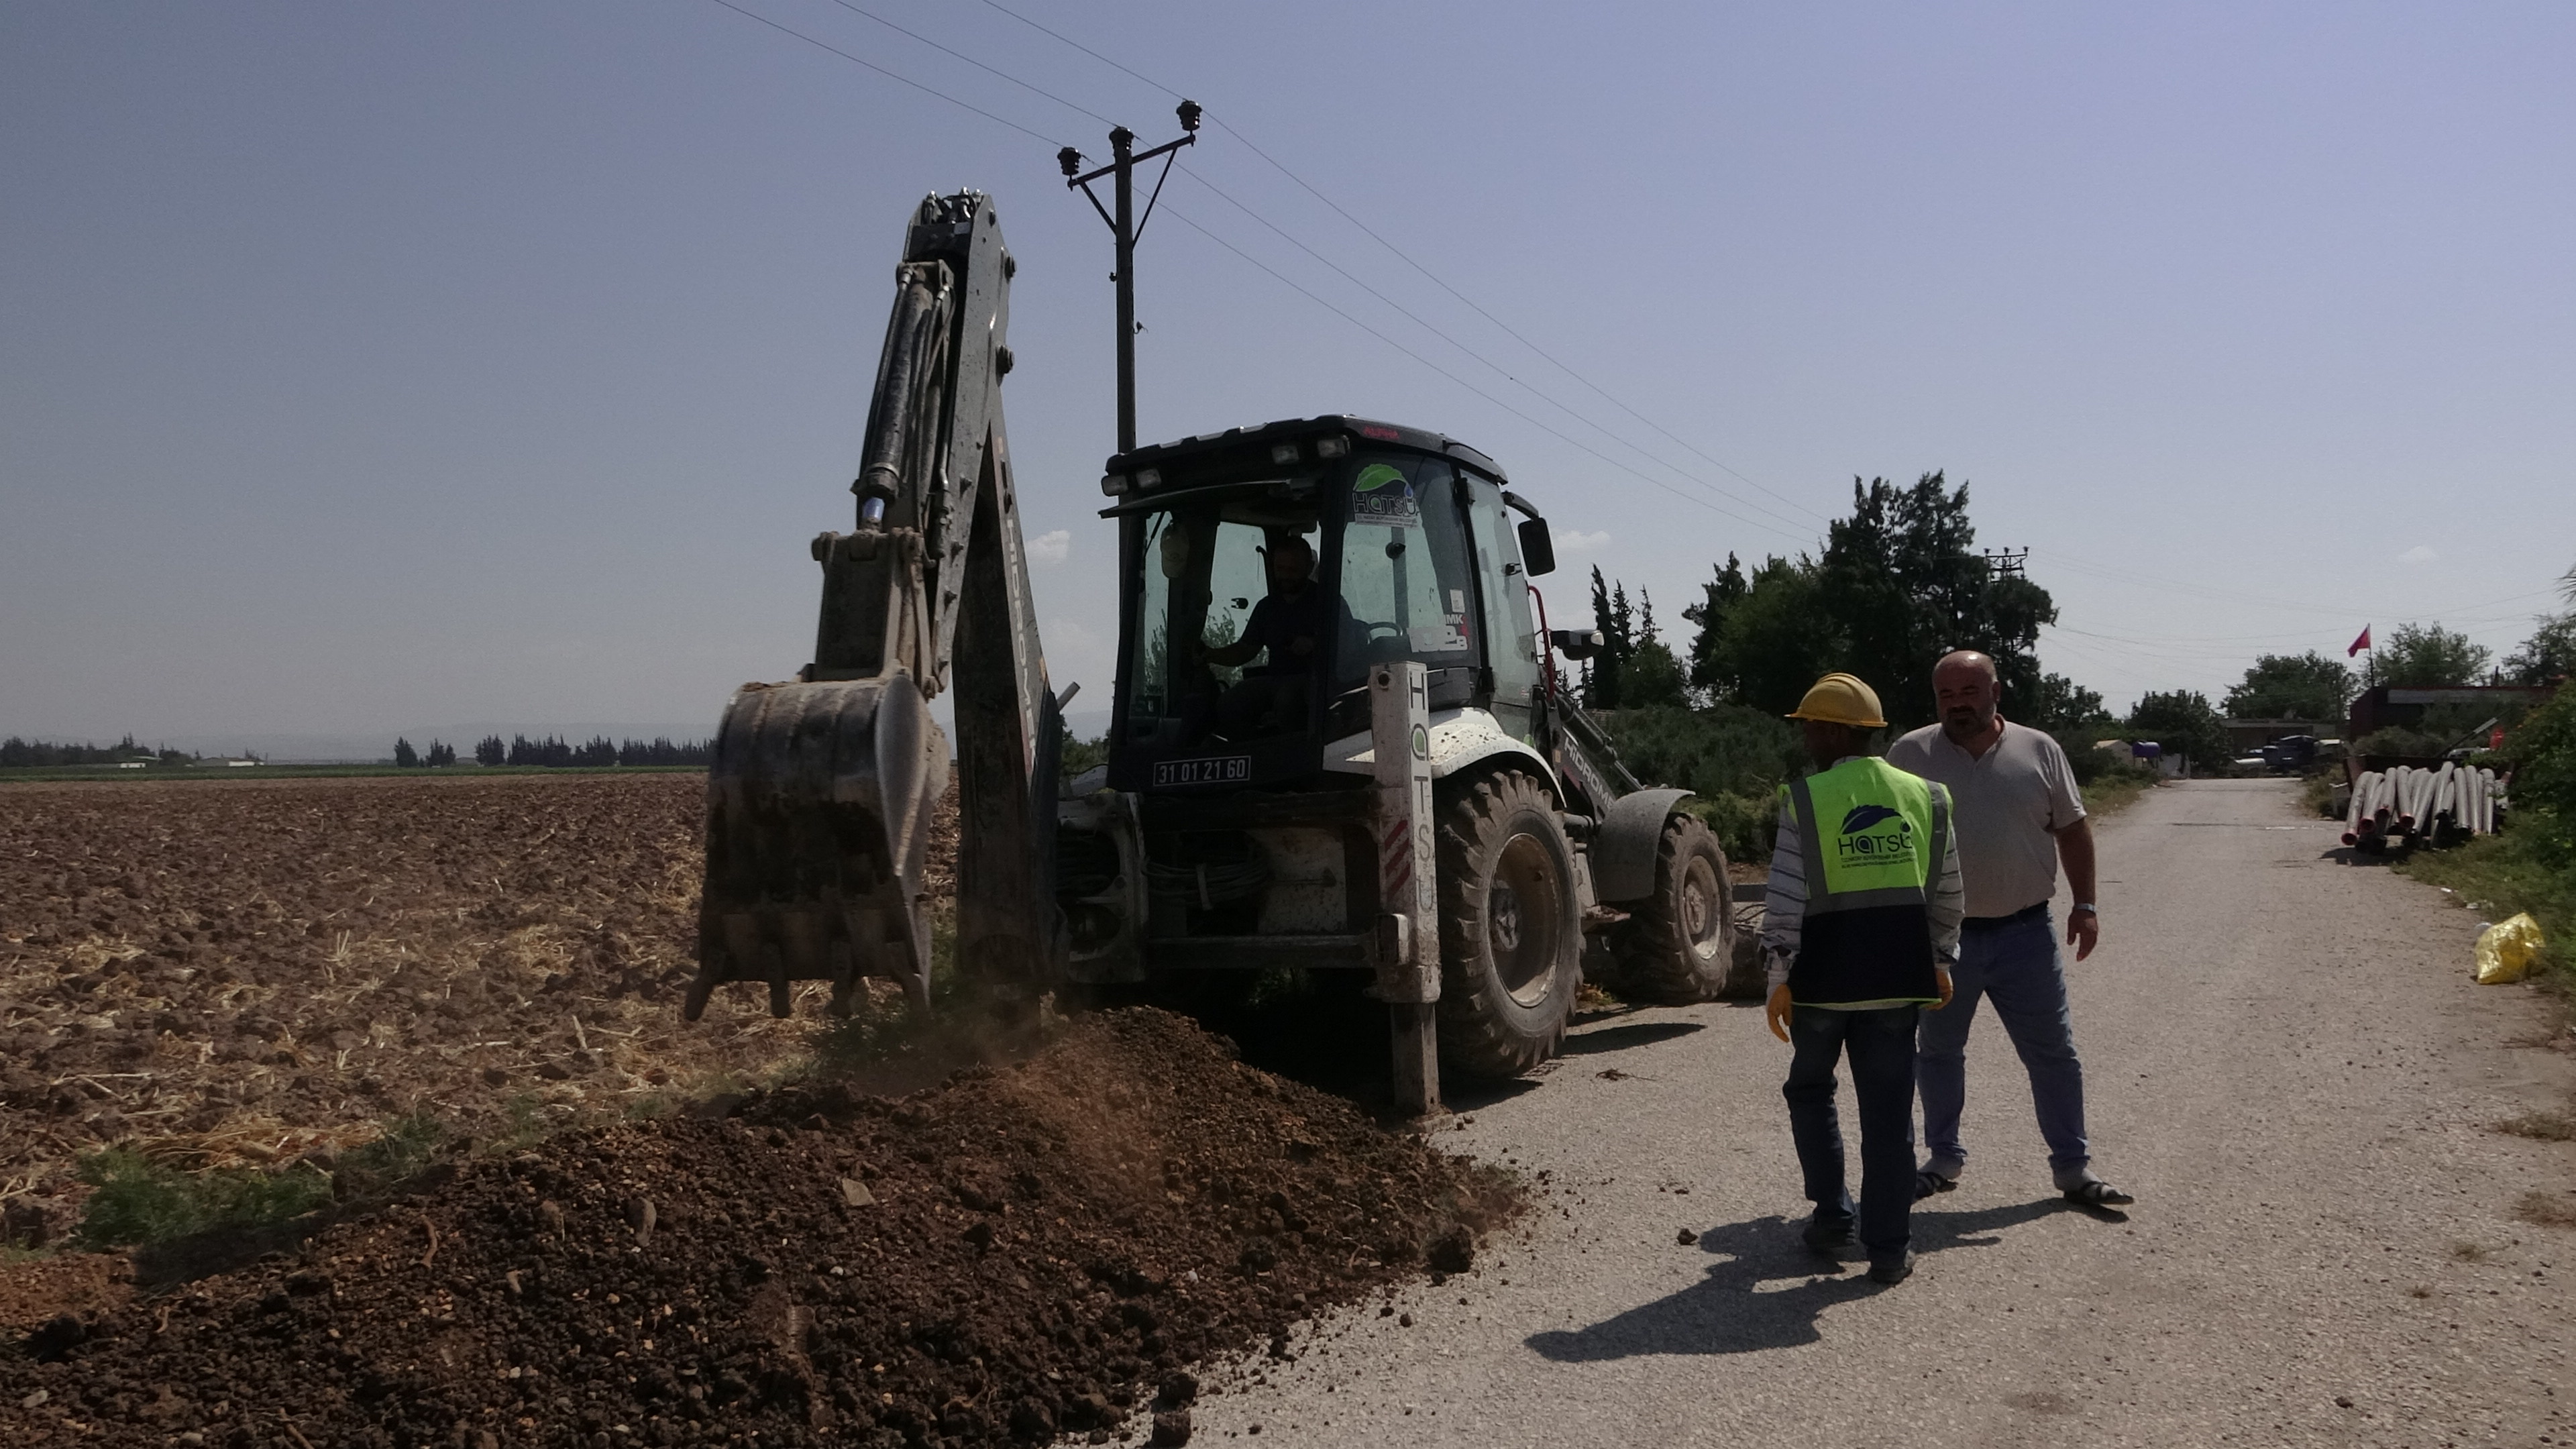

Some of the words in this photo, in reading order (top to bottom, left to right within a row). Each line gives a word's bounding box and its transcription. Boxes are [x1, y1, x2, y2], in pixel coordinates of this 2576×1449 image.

[1159, 764, 1175, 784] 31
[1181, 762, 1198, 782] 01
[1203, 761, 1221, 780] 21
[1227, 759, 1246, 779] 60
